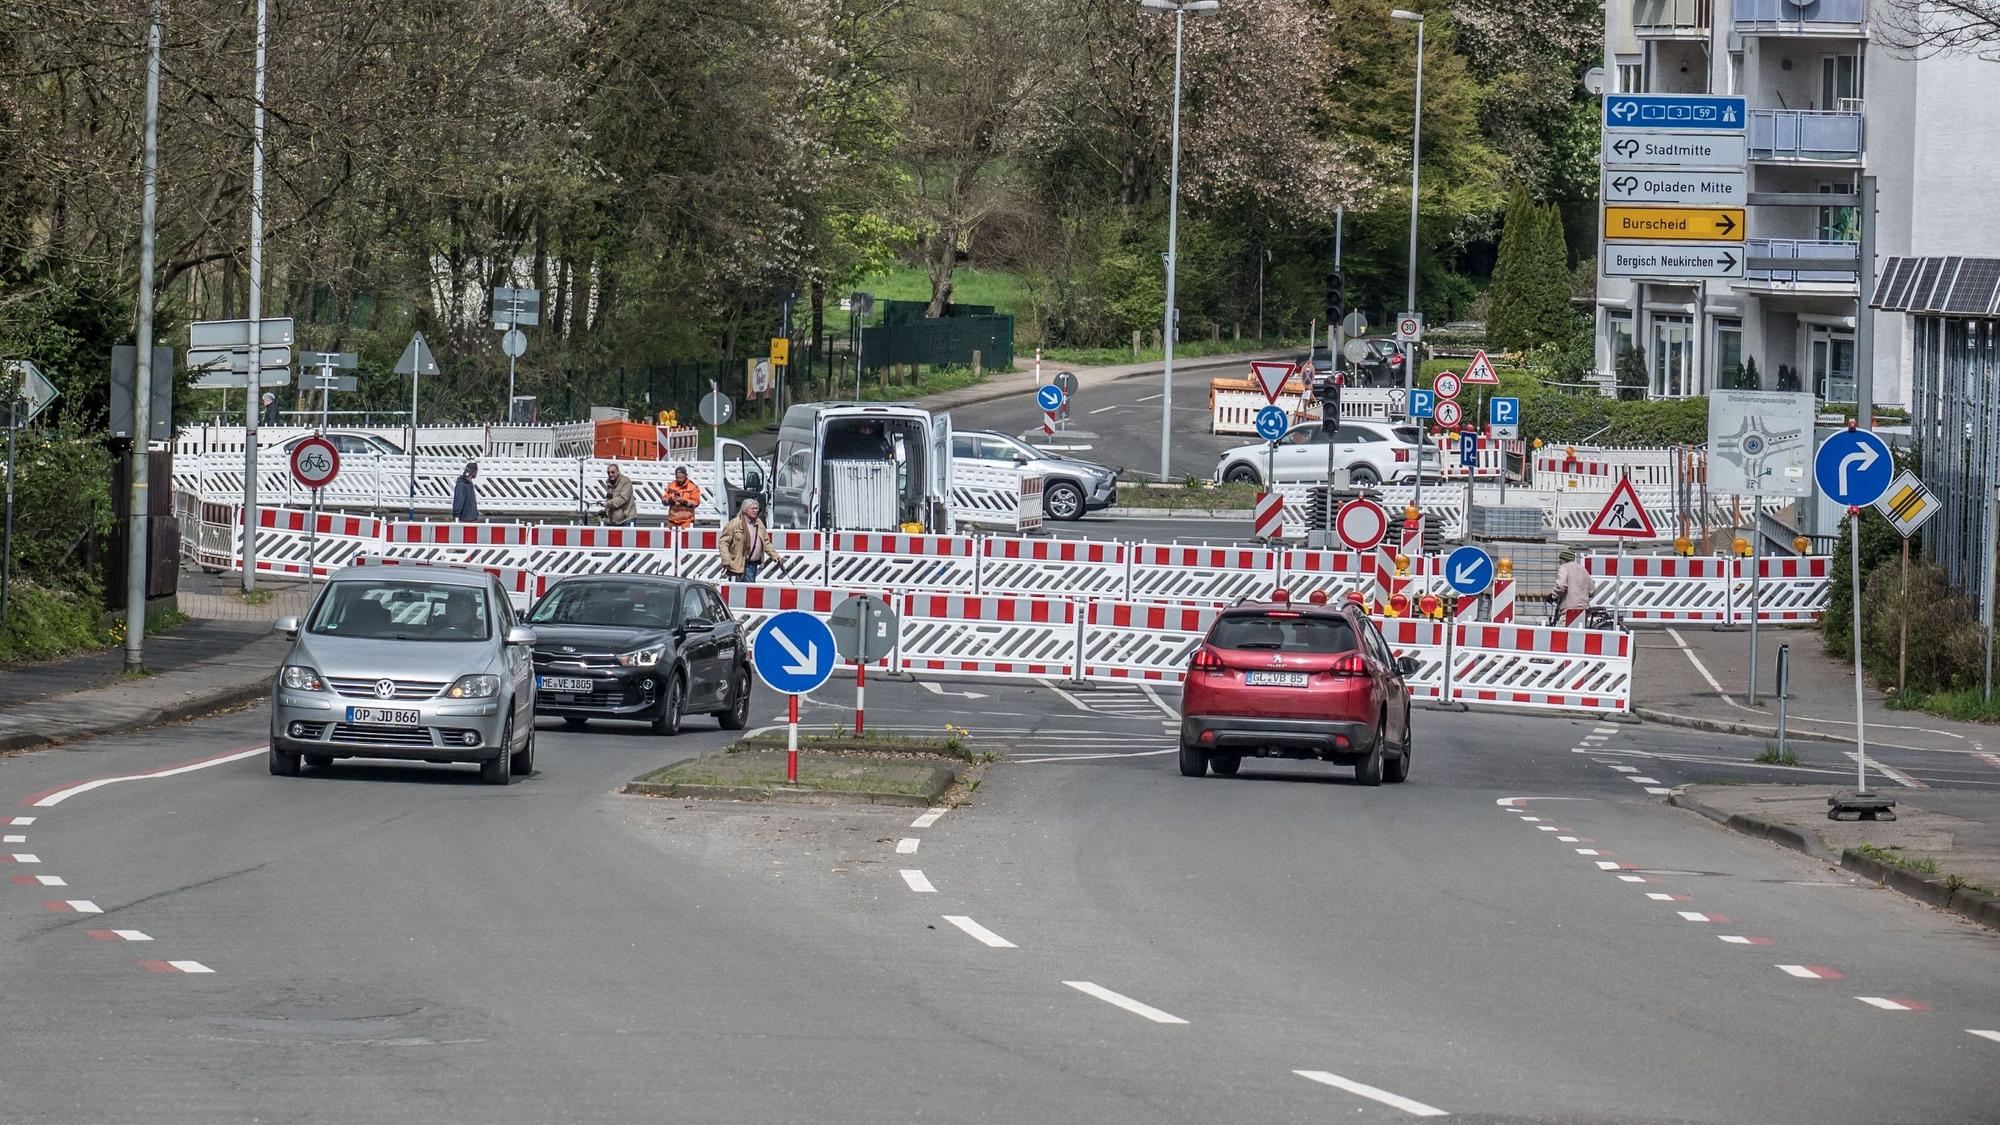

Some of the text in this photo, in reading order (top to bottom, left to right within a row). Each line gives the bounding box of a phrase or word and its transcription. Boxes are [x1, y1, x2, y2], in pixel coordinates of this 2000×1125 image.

[1676, 108, 1682, 117] 3
[1699, 108, 1711, 118] 59
[1645, 144, 1711, 156] Stadtmitte
[1644, 181, 1732, 194] Opladen Mitte
[1623, 218, 1686, 230] Burscheid
[1616, 255, 1714, 268] Bergisch Neukirchen
[1404, 323, 1414, 331] 30
[1414, 393, 1428, 414] P
[1497, 401, 1512, 422] P
[1464, 436, 1473, 462] P
[542, 678, 592, 689] ME VE 1805
[1253, 672, 1303, 683] GL VB 85
[355, 708, 417, 723] OP JD 866
